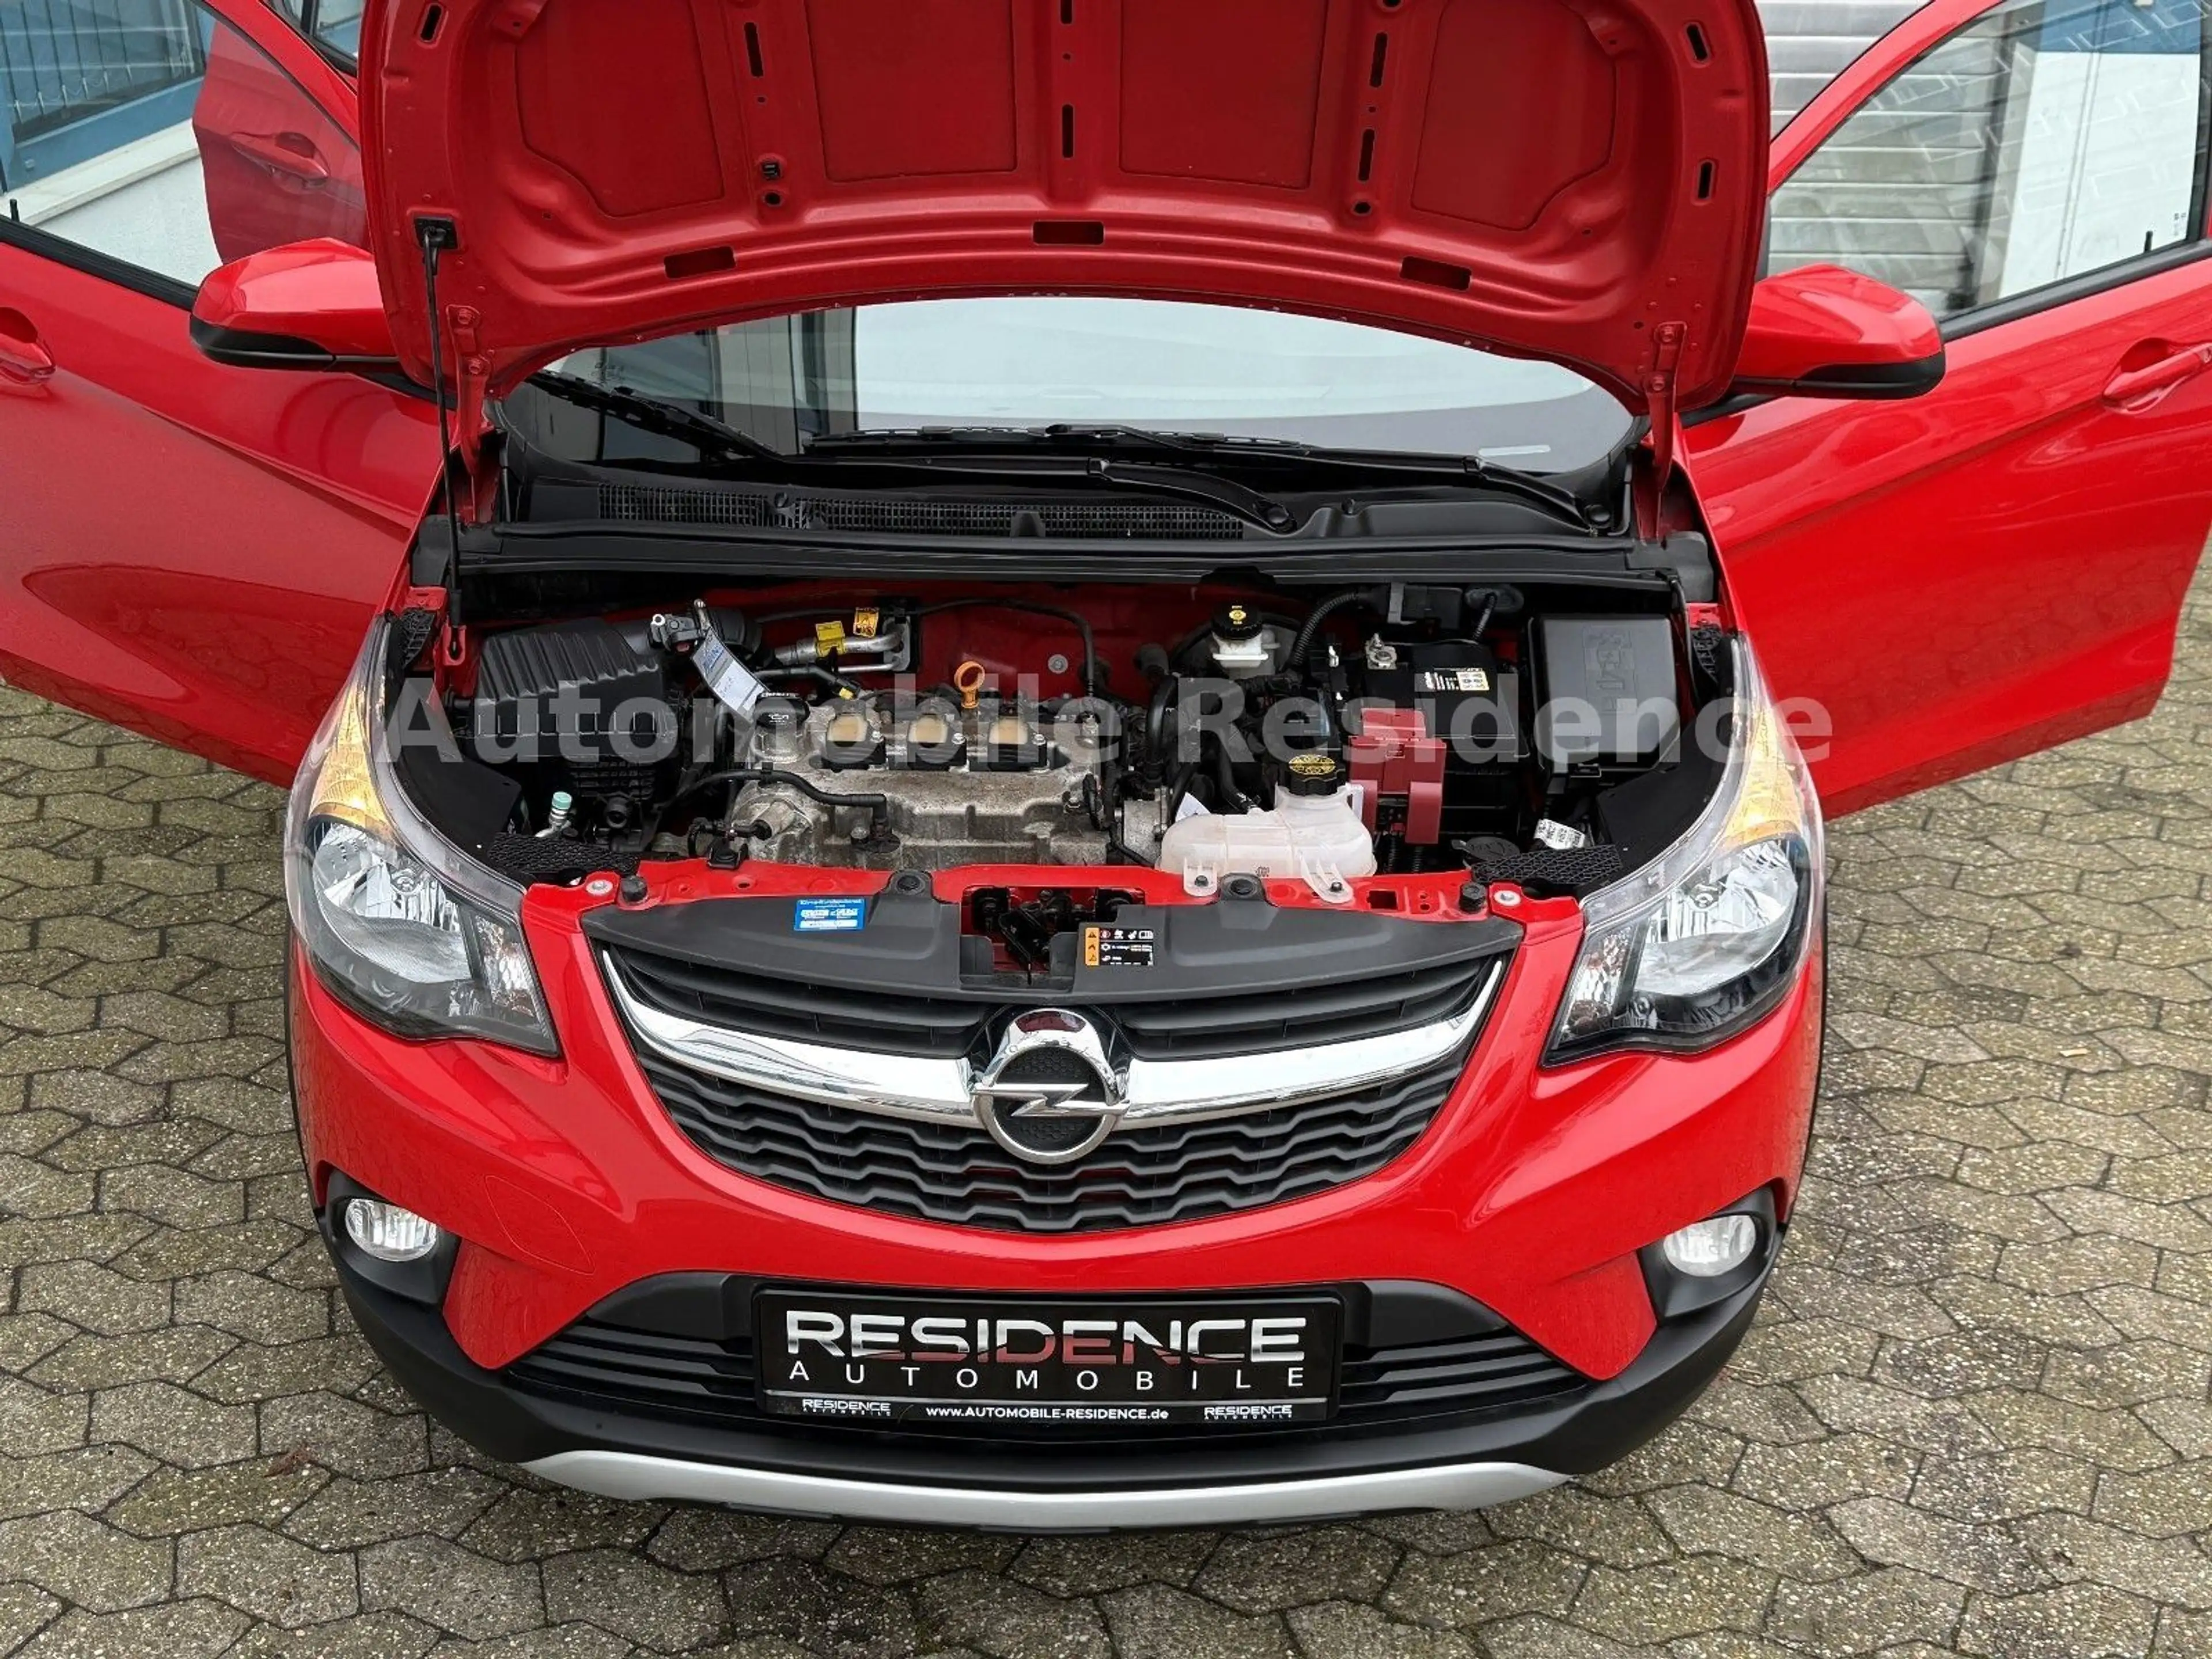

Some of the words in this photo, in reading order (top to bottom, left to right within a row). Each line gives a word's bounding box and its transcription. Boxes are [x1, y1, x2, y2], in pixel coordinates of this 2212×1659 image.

[786, 1310, 1306, 1365] RESIDENCE
[789, 1360, 1304, 1391] AUTOMOBILE
[802, 1399, 891, 1411] RESIDENCE
[1204, 1404, 1293, 1416] RESIDENCE
[926, 1407, 1169, 1420] www.AUTOMOBILE-RESIDENCE.de
